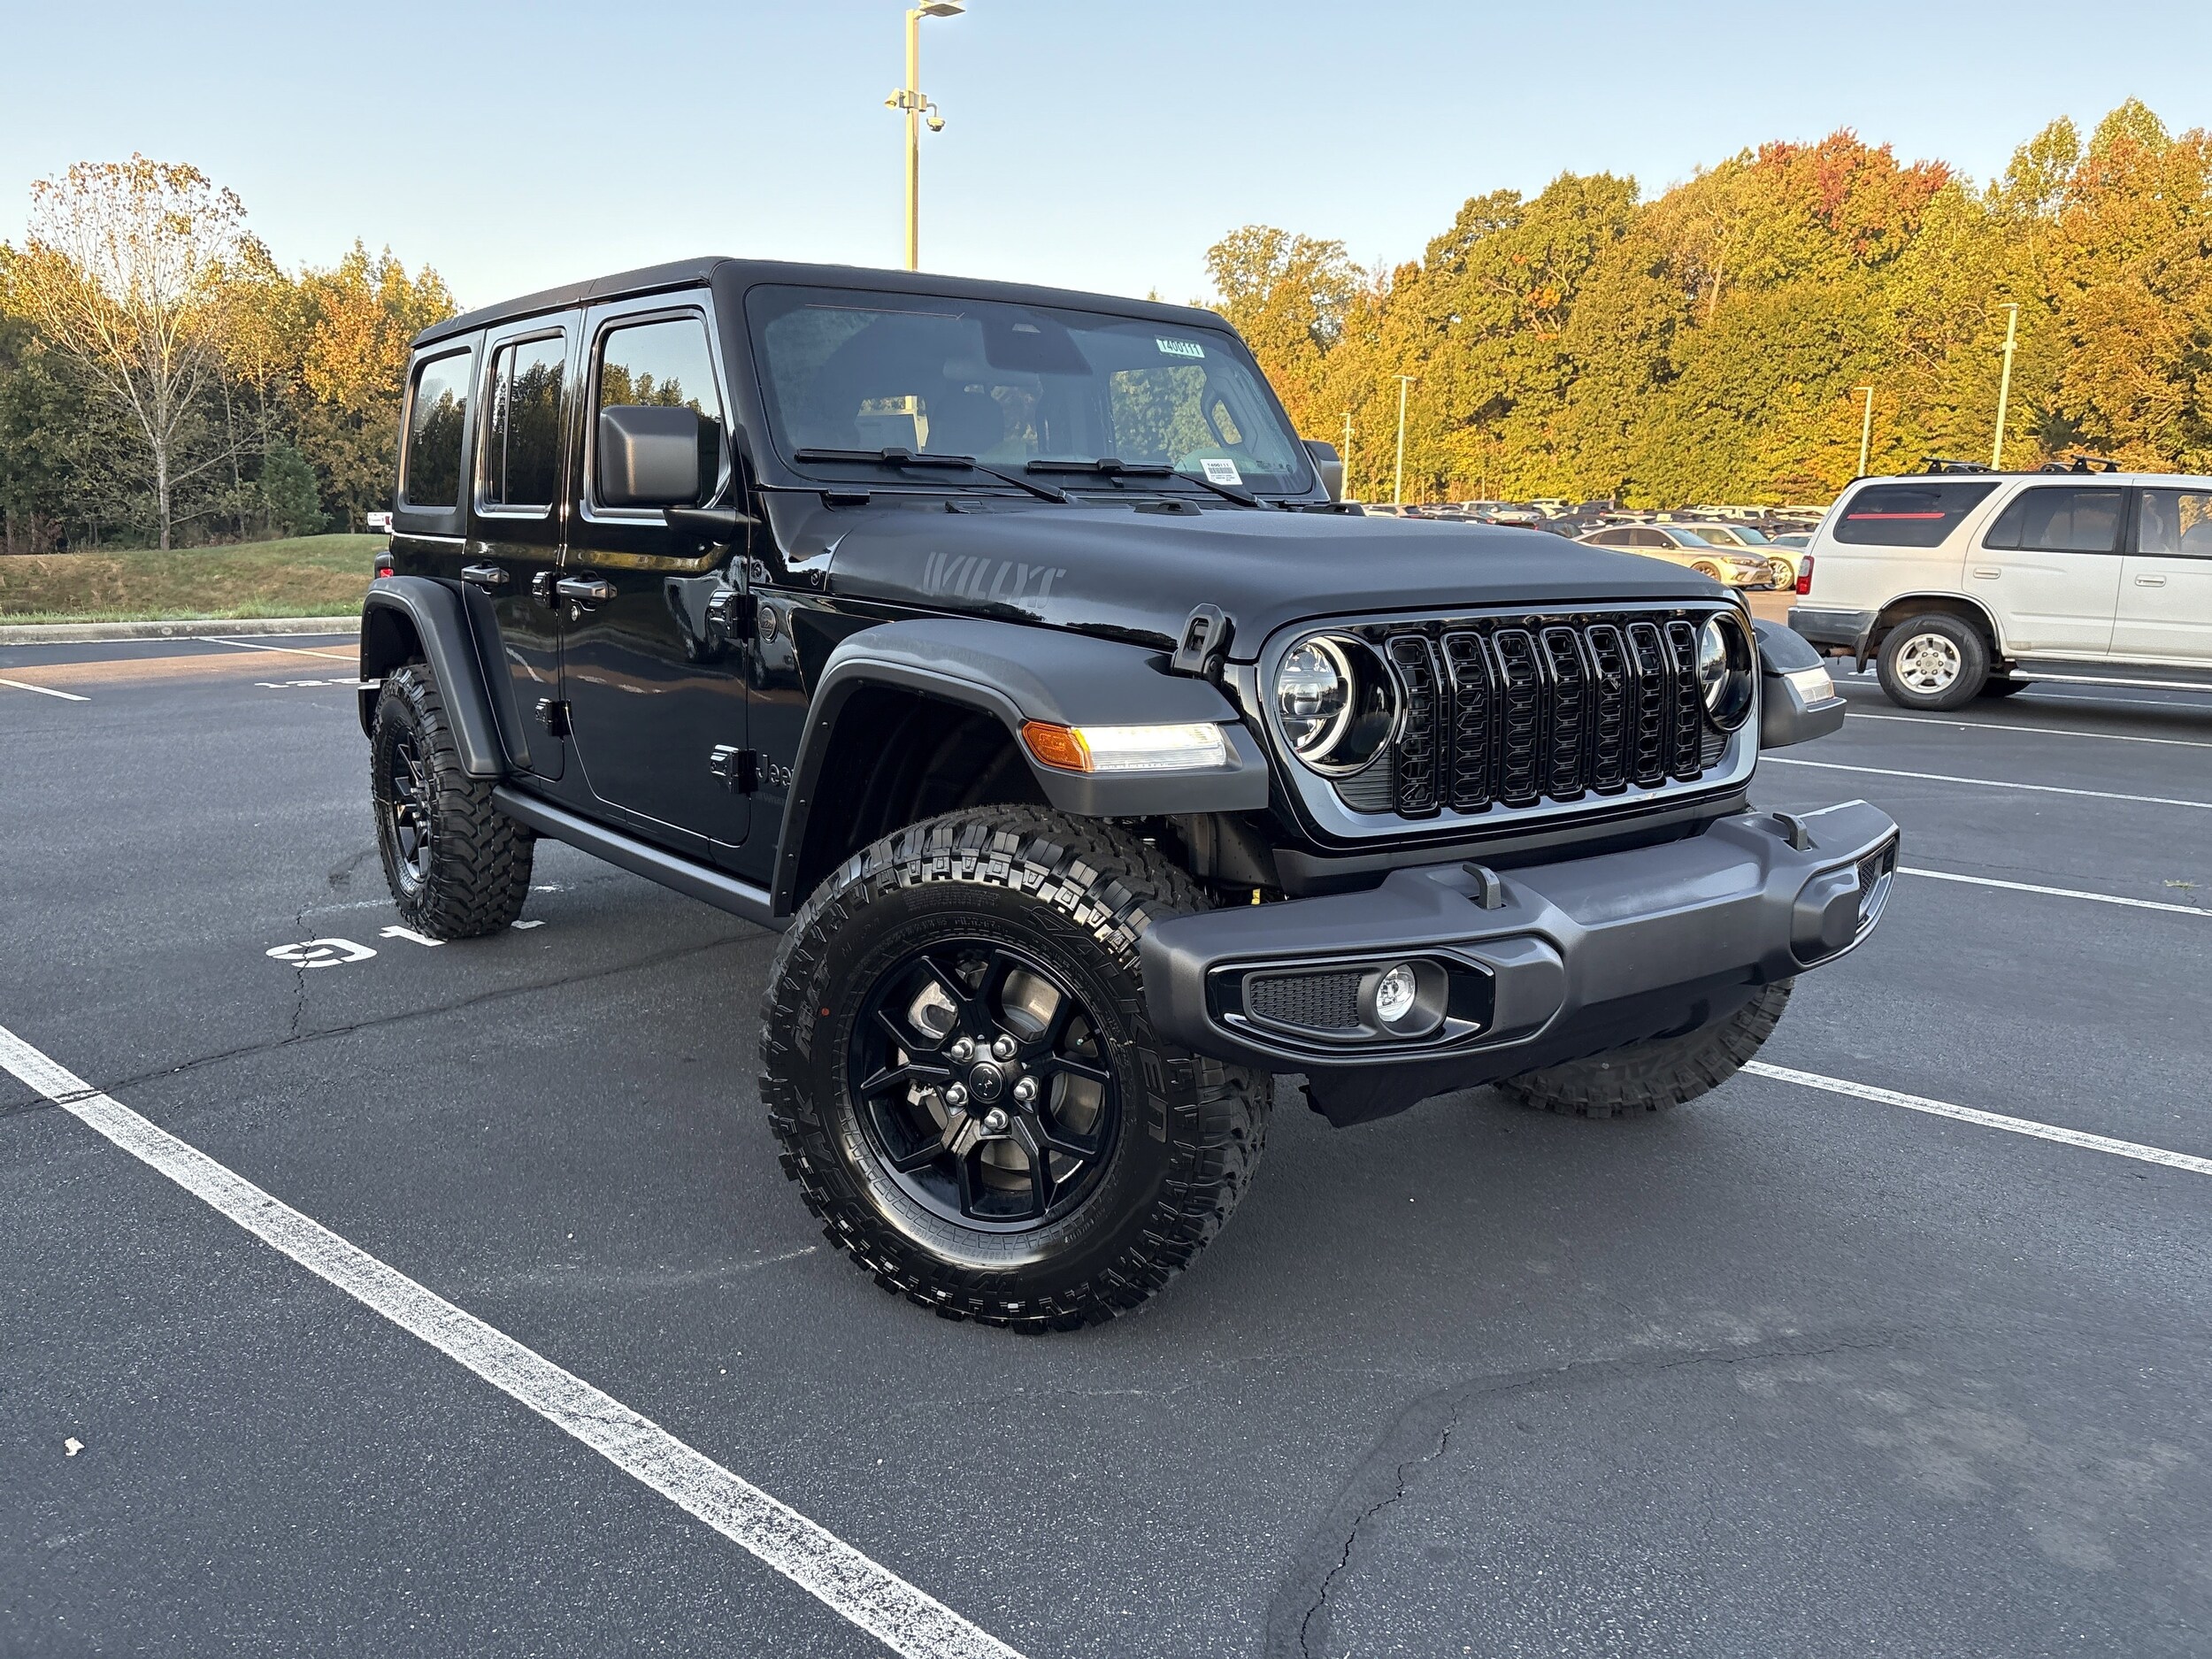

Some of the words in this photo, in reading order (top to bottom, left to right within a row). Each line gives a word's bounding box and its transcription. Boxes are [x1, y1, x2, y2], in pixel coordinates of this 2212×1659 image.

[1158, 338, 1200, 356] T400111
[922, 551, 1067, 610] WILLYS
[755, 753, 795, 787] Jee
[1019, 905, 1169, 1143] FALKEN
